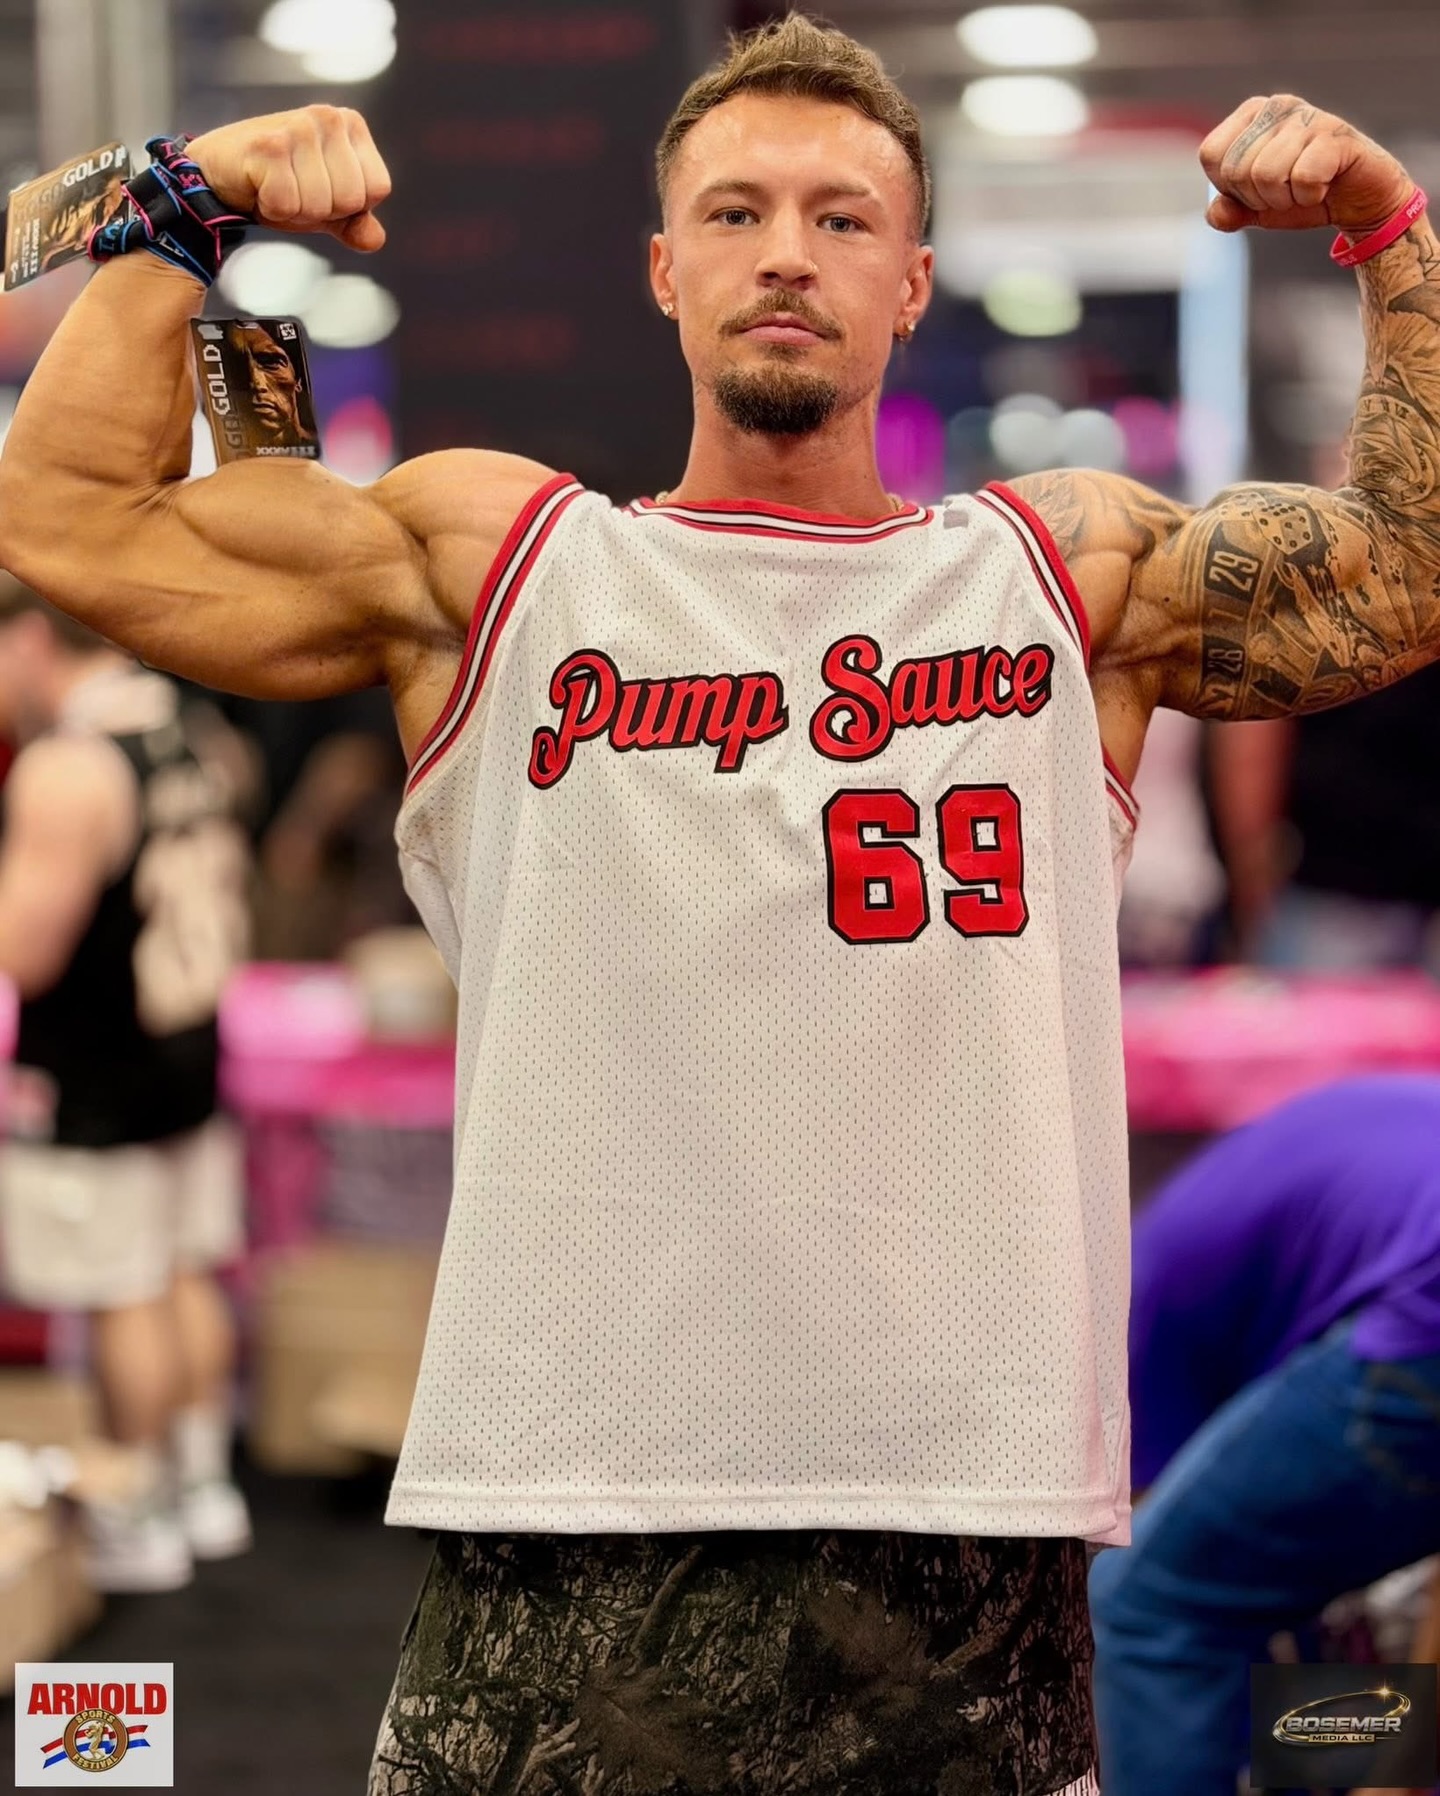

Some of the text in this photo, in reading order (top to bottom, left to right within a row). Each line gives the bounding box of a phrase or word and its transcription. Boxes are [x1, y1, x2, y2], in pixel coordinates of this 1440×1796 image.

[62, 150, 114, 187] GOLD
[203, 344, 231, 415] GOLD
[1209, 551, 1259, 593] 29
[528, 634, 1055, 790] Pump Sauce
[823, 783, 1030, 944] 69
